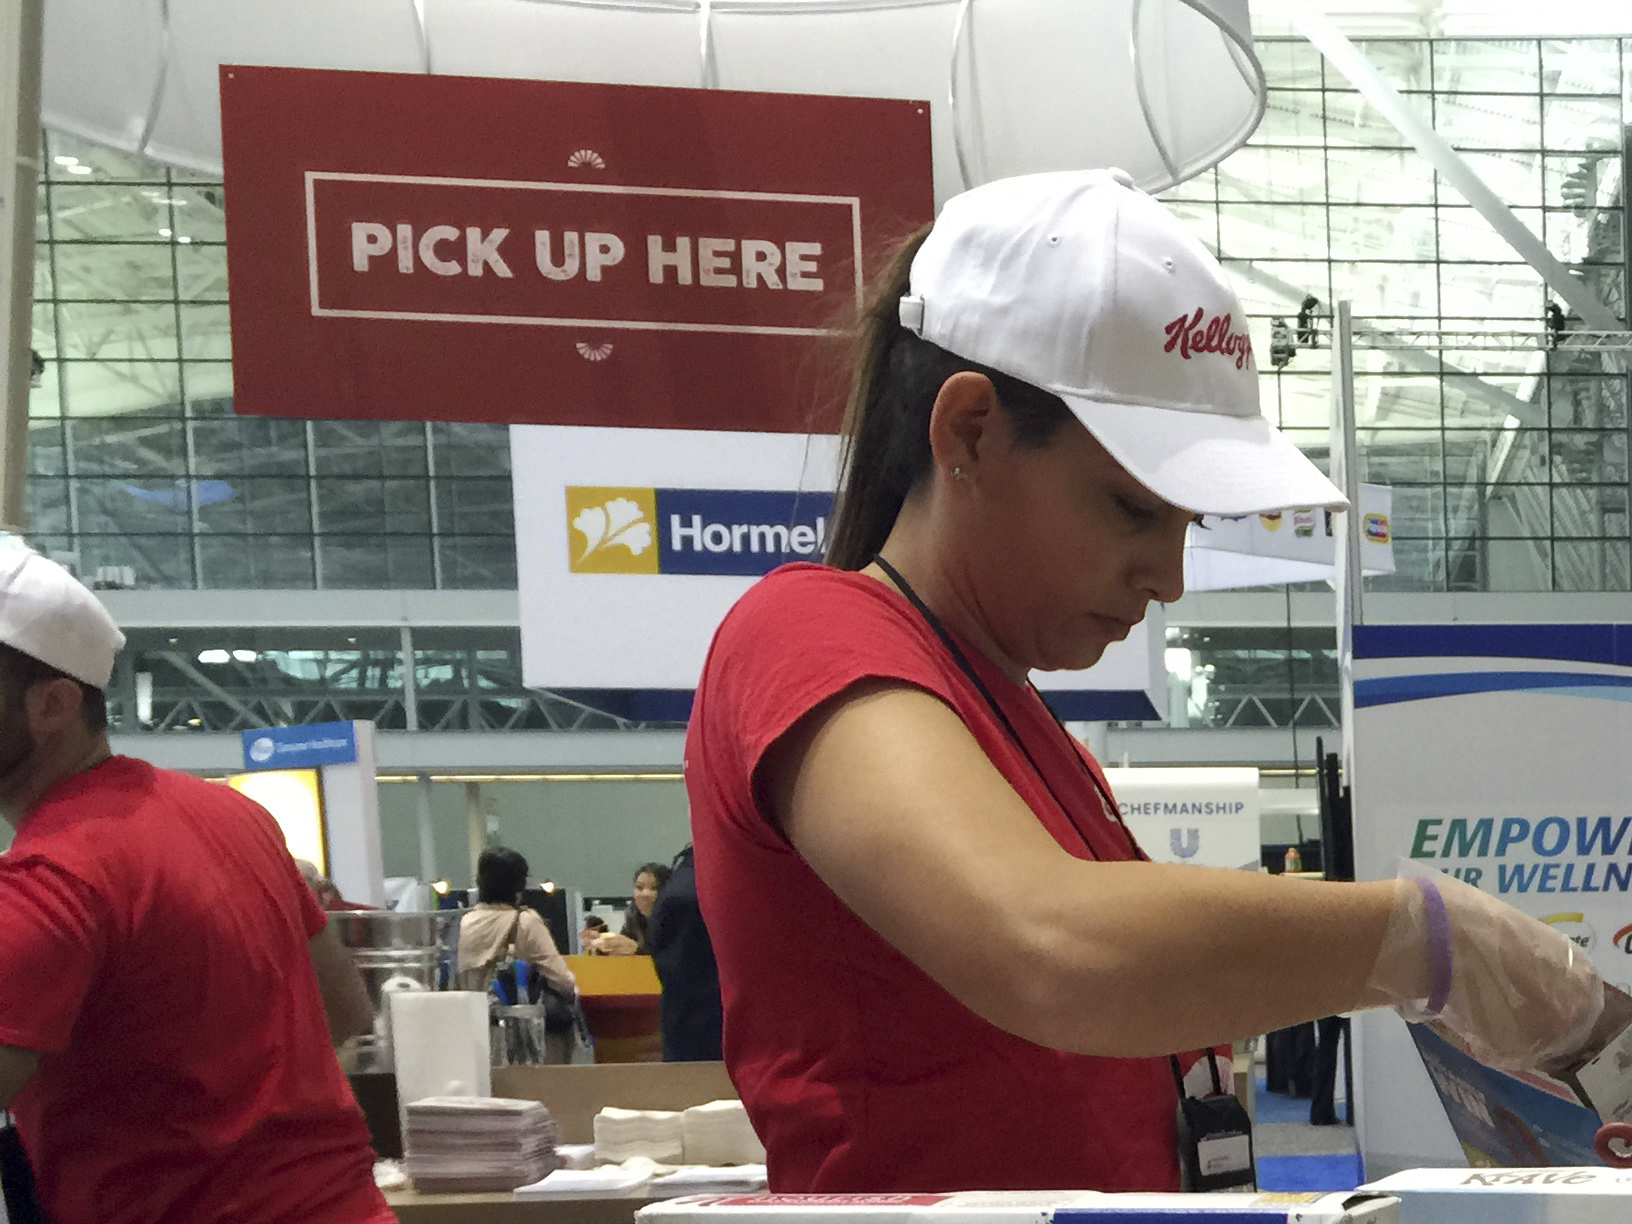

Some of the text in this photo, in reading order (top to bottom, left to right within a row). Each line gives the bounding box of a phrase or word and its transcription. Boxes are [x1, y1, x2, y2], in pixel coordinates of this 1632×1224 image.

[351, 222, 825, 291] PICK UP HERE
[670, 514, 826, 554] Hormel
[1119, 802, 1244, 815] CHEFMANSHIP
